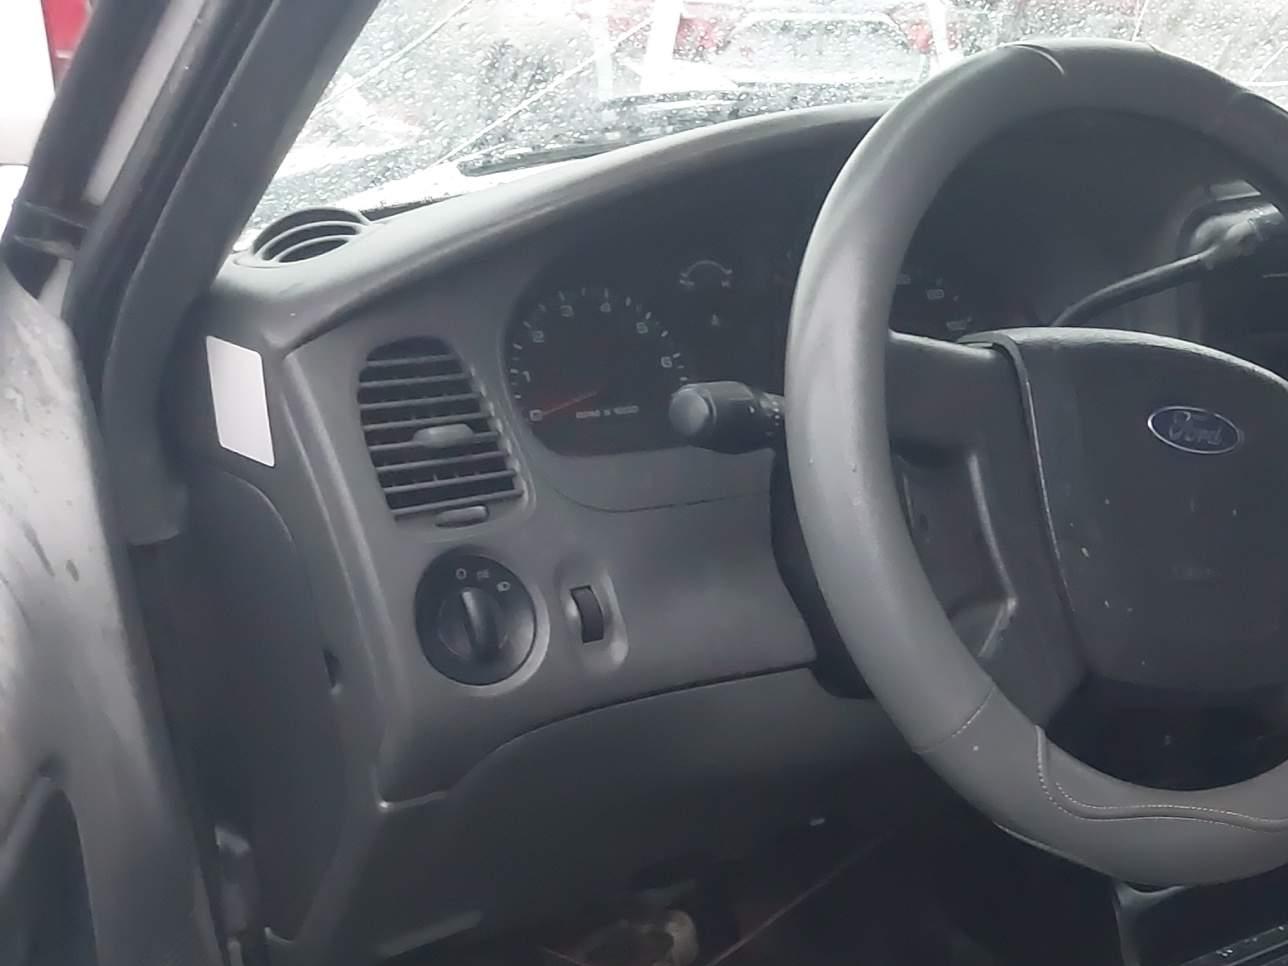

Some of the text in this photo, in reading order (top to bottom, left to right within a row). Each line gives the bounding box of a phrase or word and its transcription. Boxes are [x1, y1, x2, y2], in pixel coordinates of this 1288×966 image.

[560, 305, 575, 318] 3
[600, 302, 612, 313] 4
[635, 321, 649, 334] 5
[532, 330, 545, 344] 2
[660, 355, 673, 369] 6
